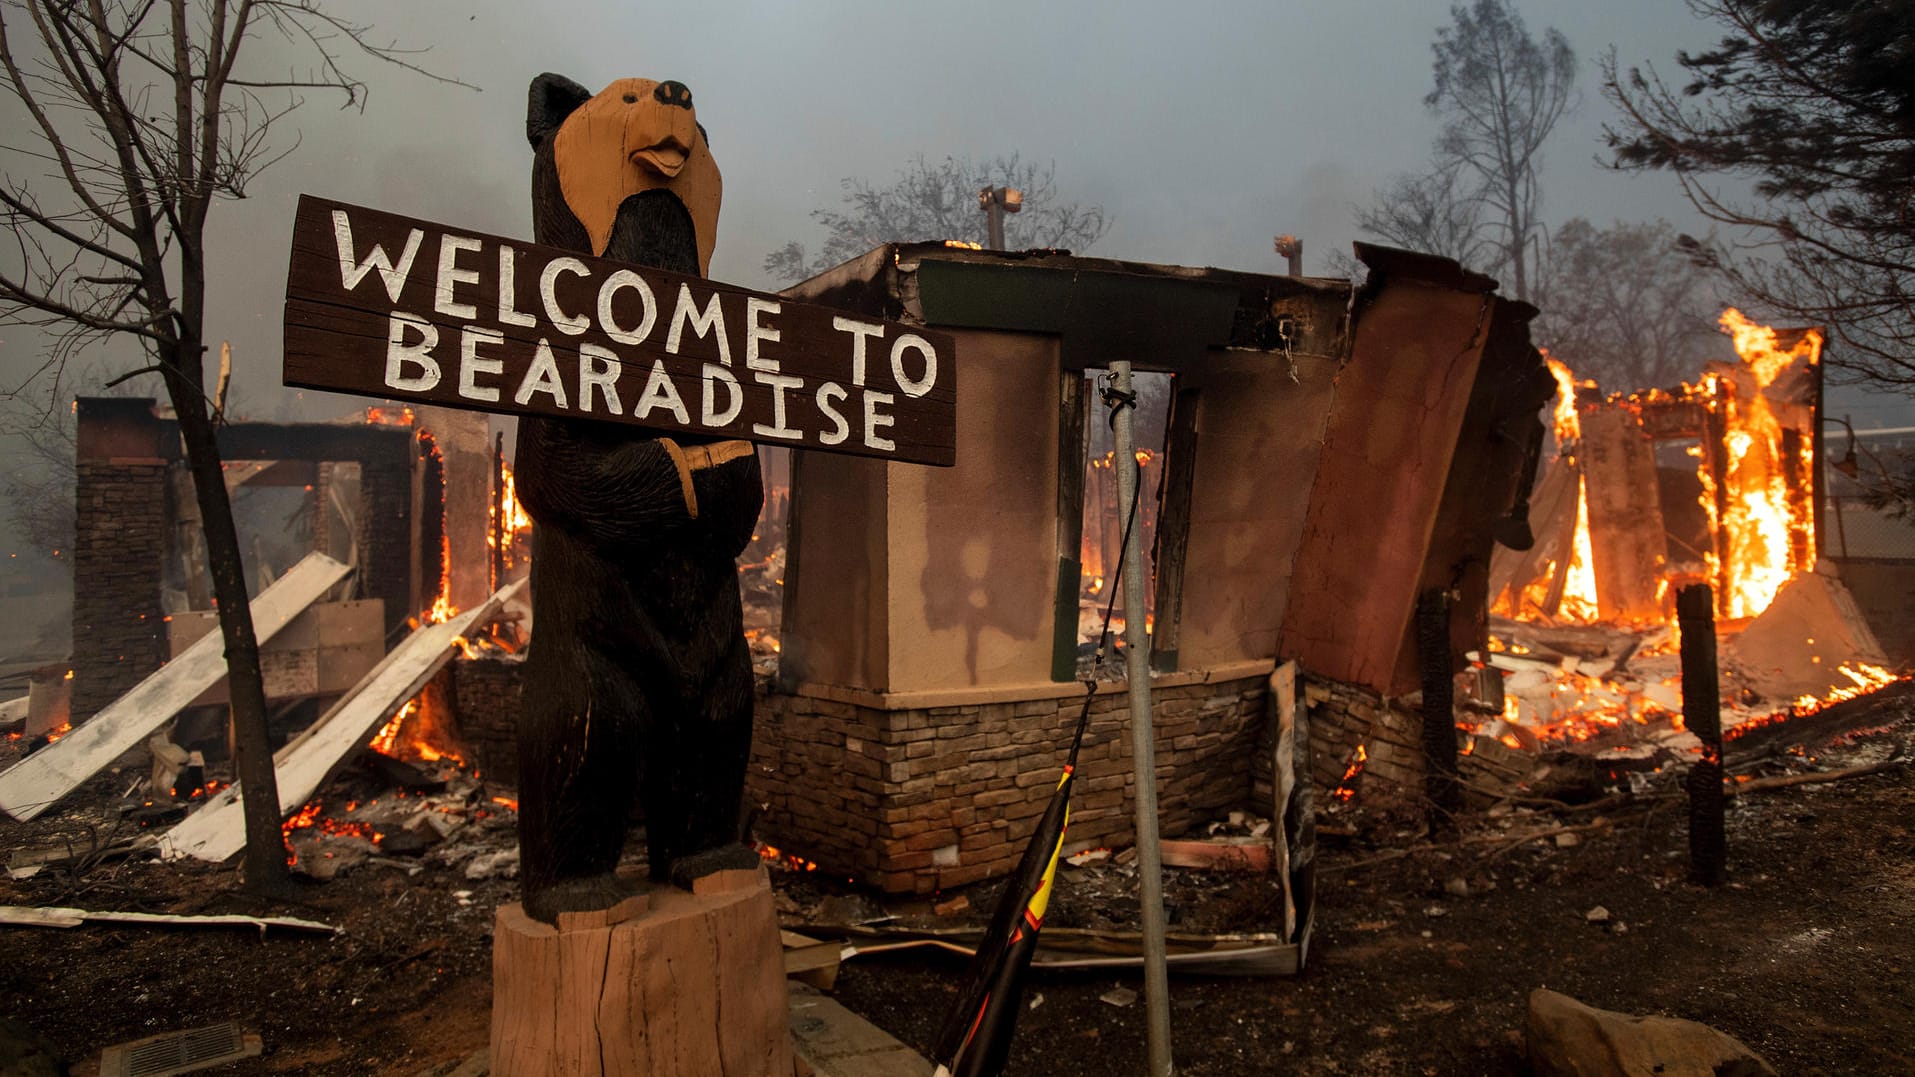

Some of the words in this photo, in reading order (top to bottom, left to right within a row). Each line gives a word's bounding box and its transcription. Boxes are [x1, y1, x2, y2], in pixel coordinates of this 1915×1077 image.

[331, 210, 783, 373] WELCOME
[833, 316, 937, 398] TO
[384, 311, 896, 452] BEARADISE
